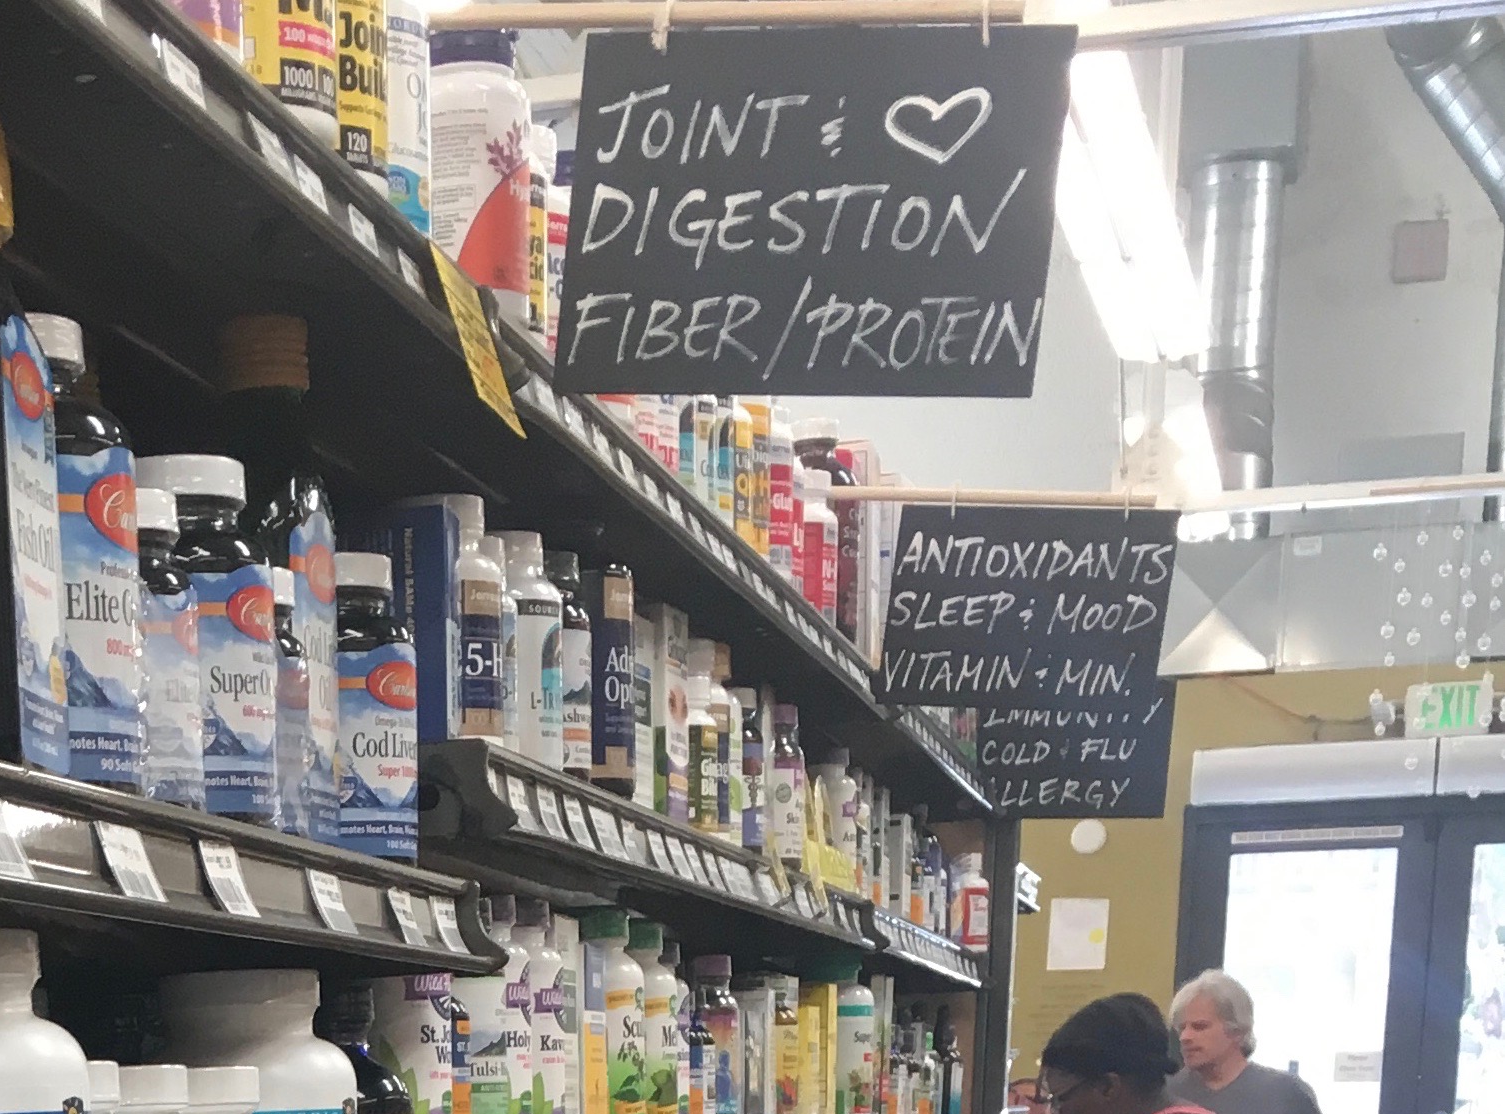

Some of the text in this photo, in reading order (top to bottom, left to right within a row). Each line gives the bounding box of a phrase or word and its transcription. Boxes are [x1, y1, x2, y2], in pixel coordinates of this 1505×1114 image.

[284, 64, 314, 89] 1000
[347, 131, 367, 152] 120
[596, 83, 811, 165] JOINT
[581, 168, 1028, 271] DIGESTION
[896, 531, 1174, 585] ANTIOXIDANTS
[65, 582, 119, 623] Elite
[891, 590, 1016, 634] SLEEP
[1047, 593, 1158, 635] MOOD
[210, 665, 258, 702] Super
[884, 648, 1032, 693] VITAMIN
[1055, 652, 1137, 697] MIN.
[1421, 684, 1481, 731] EXIT
[352, 731, 388, 758] Cod
[982, 738, 1137, 766] COLD FLU
[421, 1024, 439, 1044] St.
